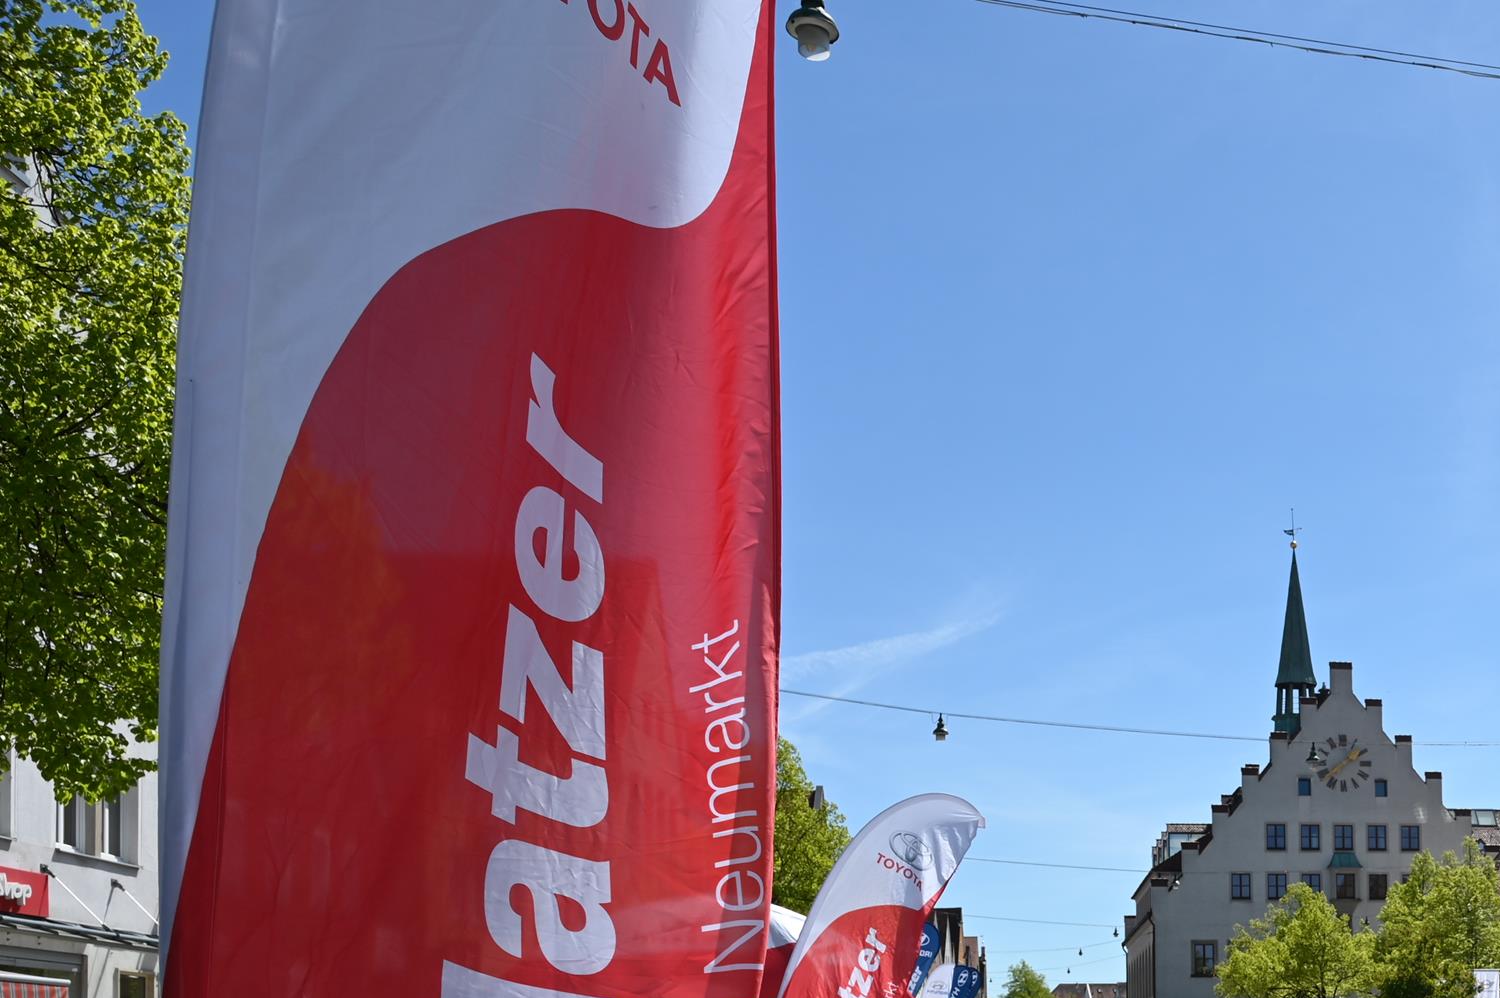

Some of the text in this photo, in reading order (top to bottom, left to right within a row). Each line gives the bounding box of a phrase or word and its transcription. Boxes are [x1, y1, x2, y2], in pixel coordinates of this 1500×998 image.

[560, 0, 682, 108] OTA
[689, 619, 766, 976] Neumarkt
[876, 852, 922, 892] TOYOTA
